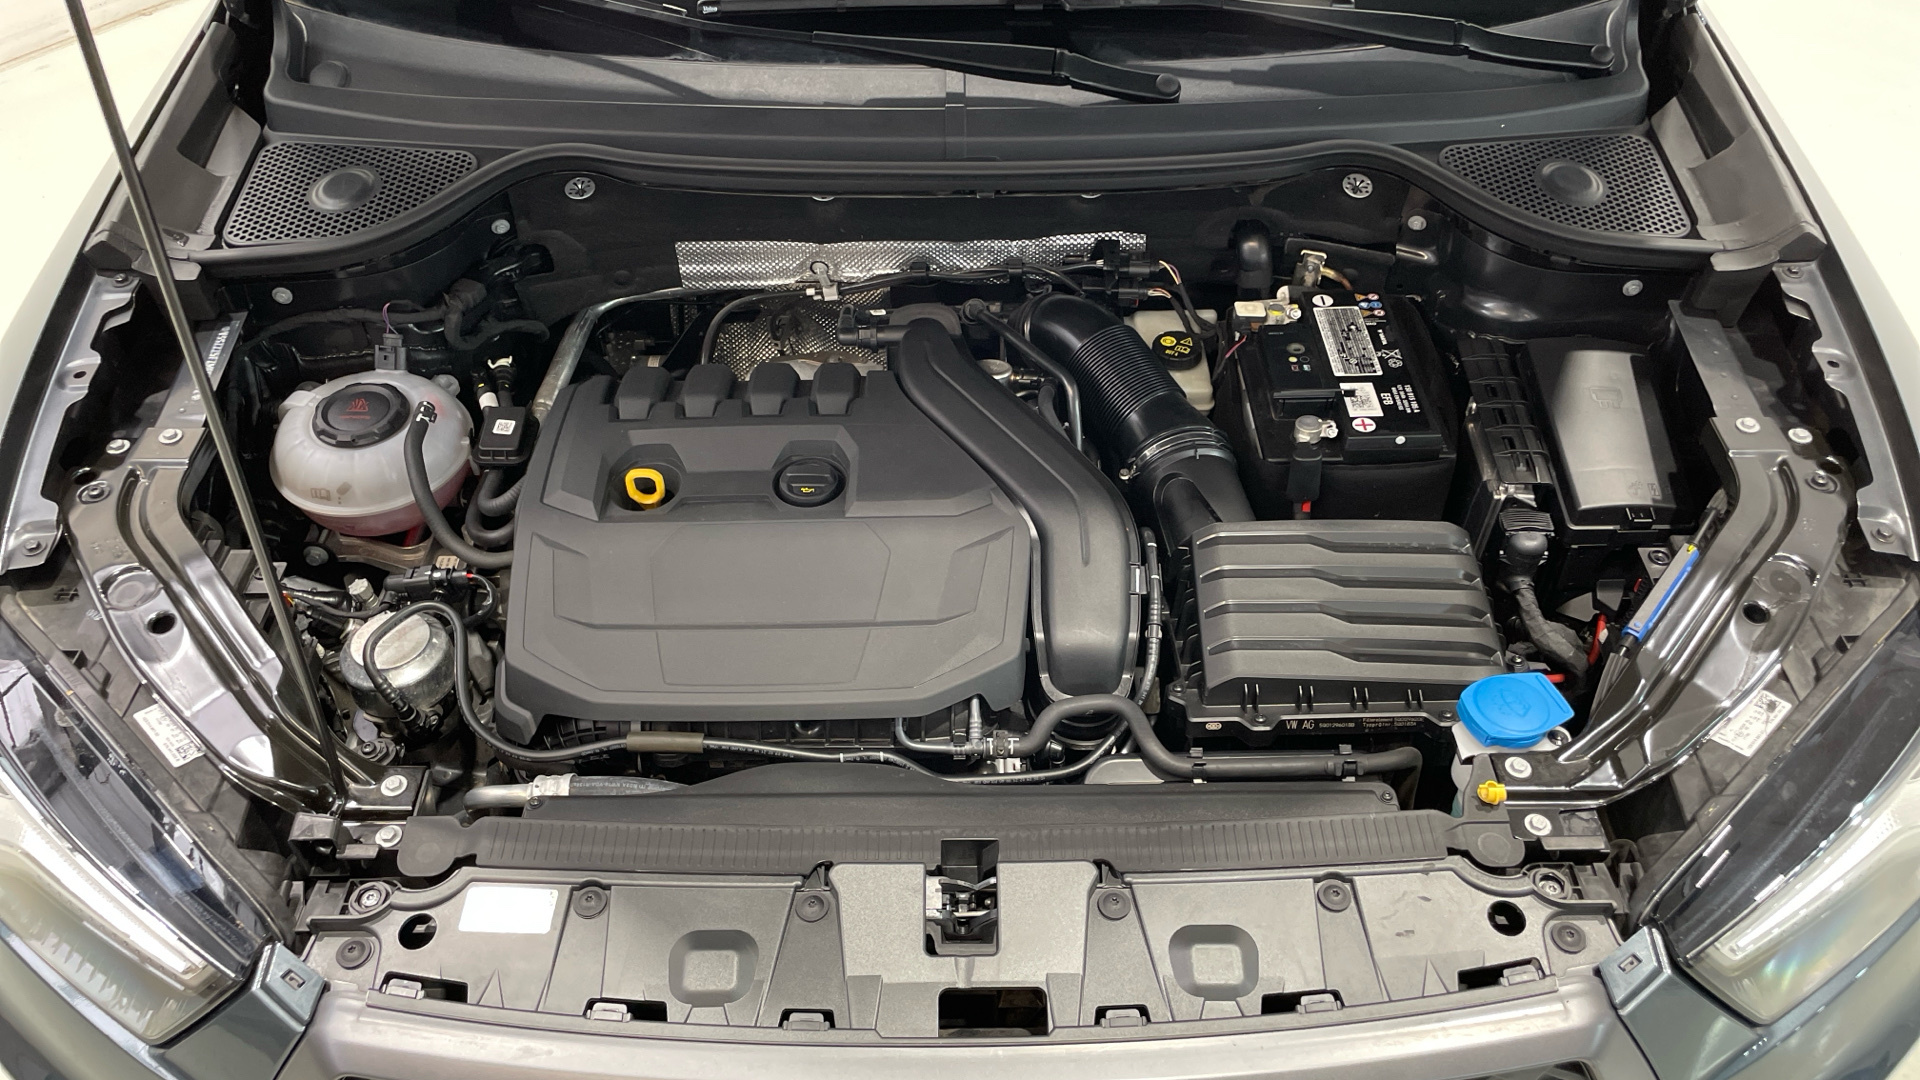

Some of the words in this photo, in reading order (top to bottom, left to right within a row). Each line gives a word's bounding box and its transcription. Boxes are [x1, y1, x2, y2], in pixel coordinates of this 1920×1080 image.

[1380, 392, 1393, 406] EFB
[1285, 719, 1299, 730] VW
[1302, 719, 1315, 730] AG
